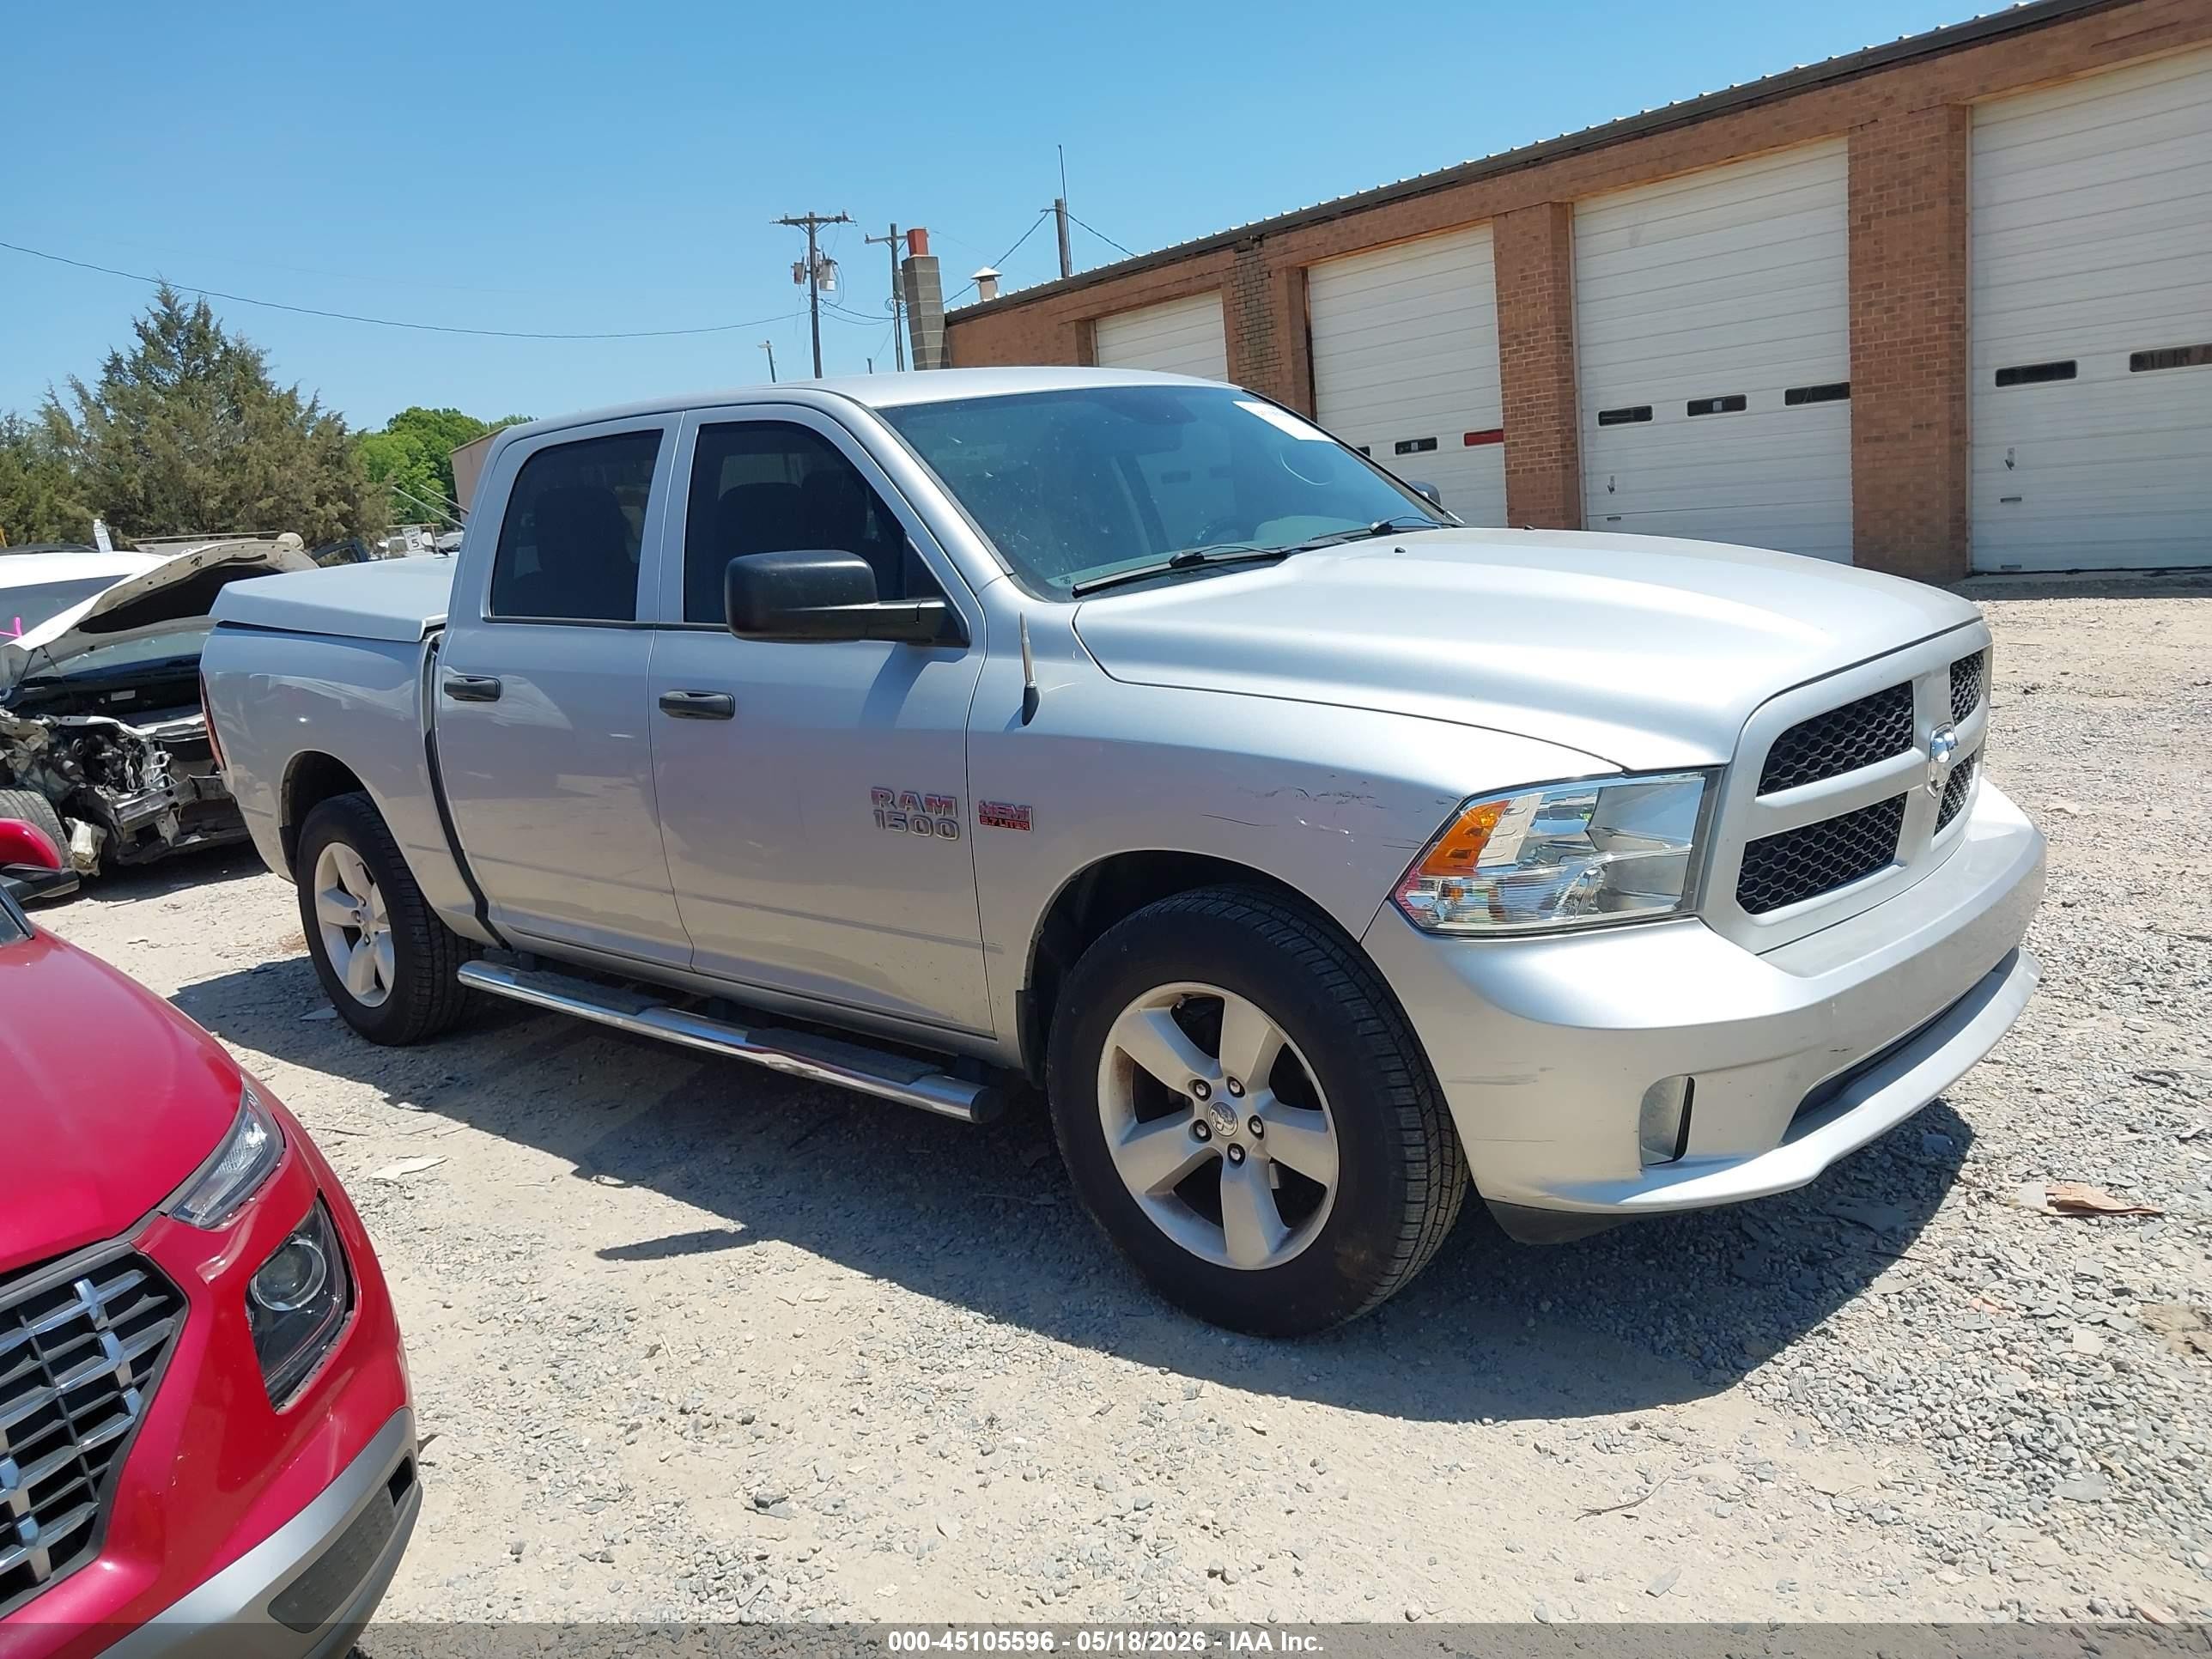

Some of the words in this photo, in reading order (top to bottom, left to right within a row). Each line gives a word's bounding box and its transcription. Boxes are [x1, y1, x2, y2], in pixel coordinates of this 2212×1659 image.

[411, 538, 419, 548] 5
[871, 787, 957, 817] RAM
[978, 799, 1031, 821] HEMI
[872, 809, 959, 841] 1500
